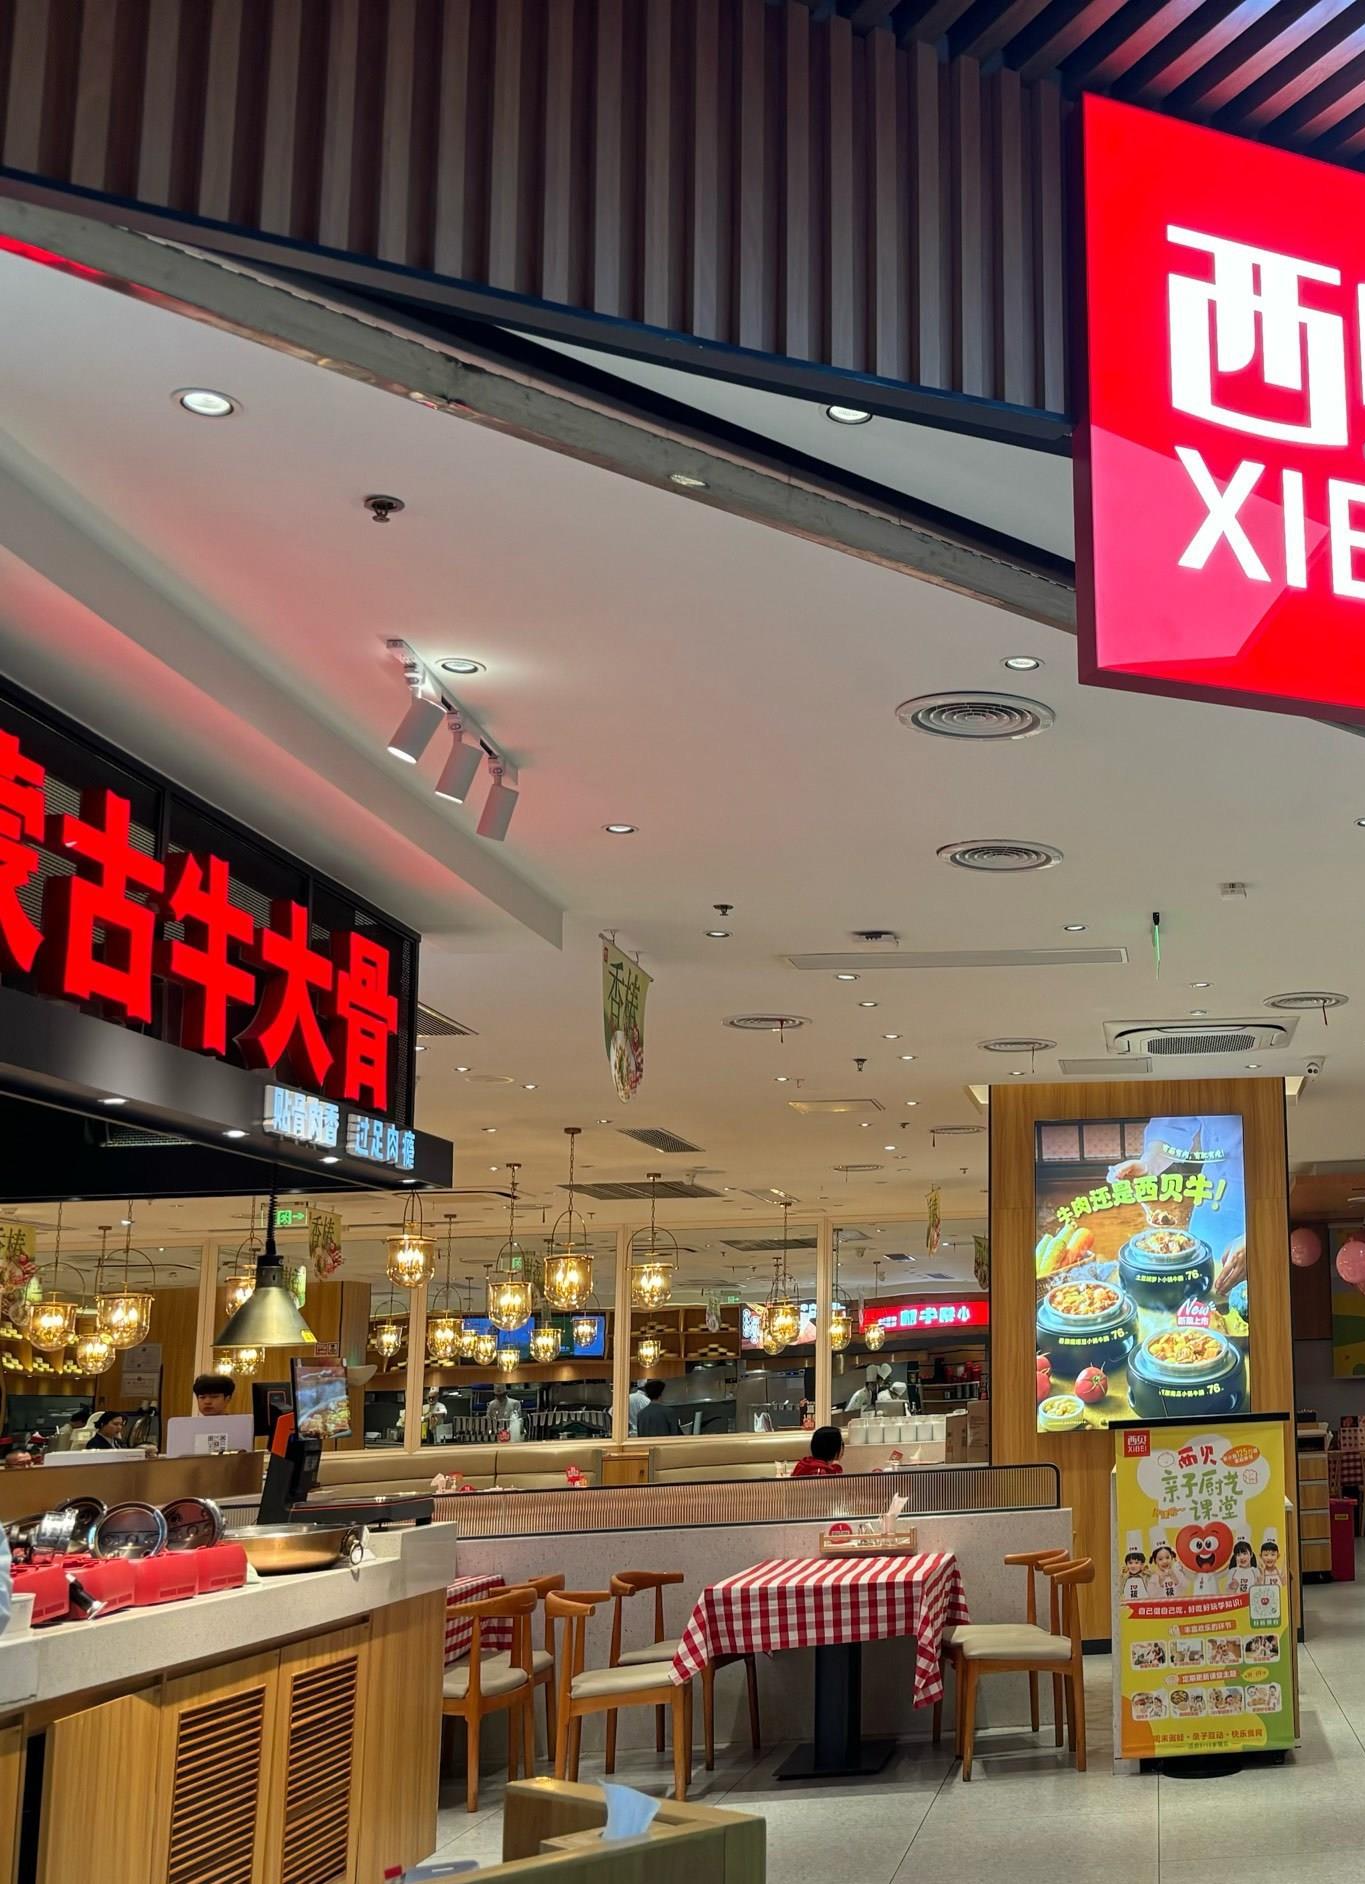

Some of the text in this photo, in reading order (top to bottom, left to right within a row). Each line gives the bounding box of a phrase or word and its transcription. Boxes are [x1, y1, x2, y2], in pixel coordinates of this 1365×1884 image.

[1177, 1297, 1209, 1316] New
[1127, 1435, 1147, 1446] 西贝
[1178, 1445, 1217, 1470] 西贝
[1161, 1469, 1243, 1504] 亲子厨艺
[1190, 1496, 1238, 1521] 课堂
